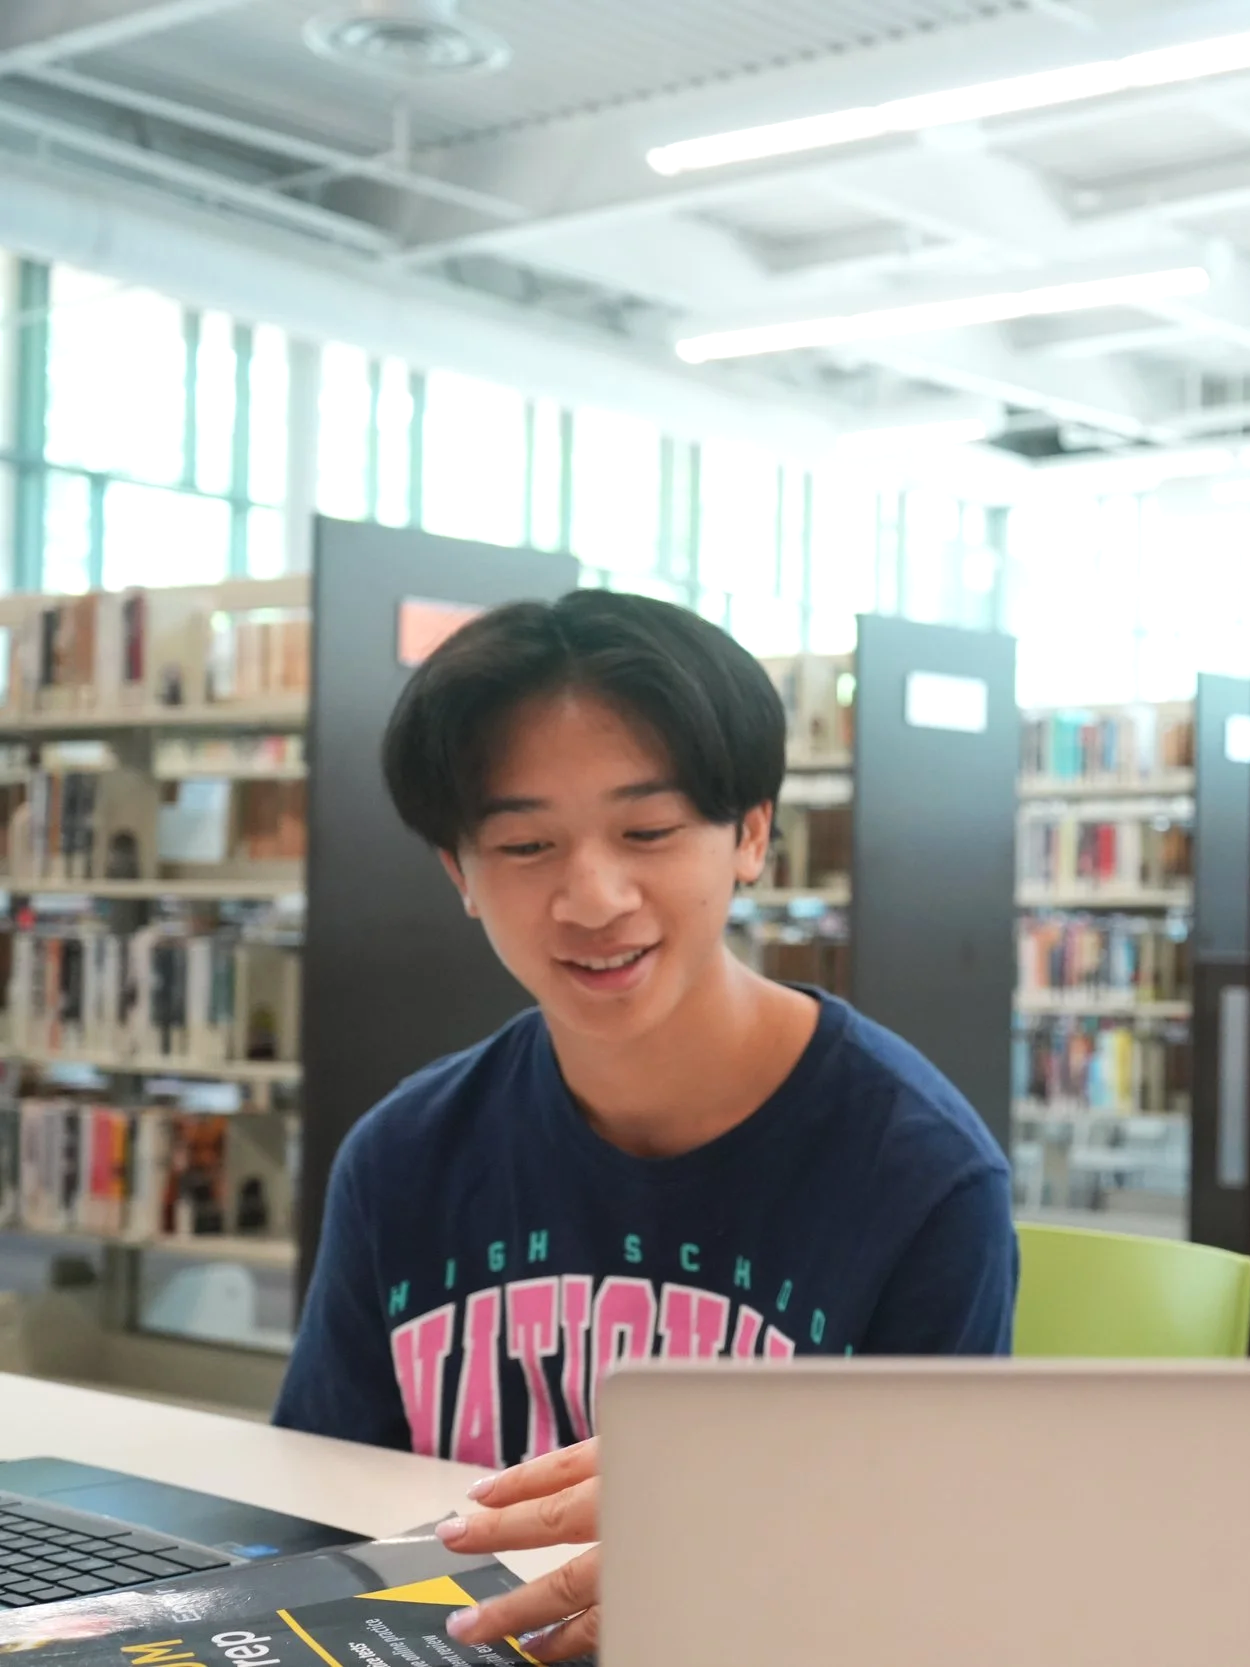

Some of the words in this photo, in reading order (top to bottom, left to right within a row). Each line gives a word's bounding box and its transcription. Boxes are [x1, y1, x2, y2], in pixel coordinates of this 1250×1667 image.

[388, 1229, 548, 1317] HIGH
[390, 1273, 796, 1472] NATIO
[365, 1618, 406, 1643] practice
[389, 1641, 421, 1661] online
[421, 1634, 455, 1656] review
